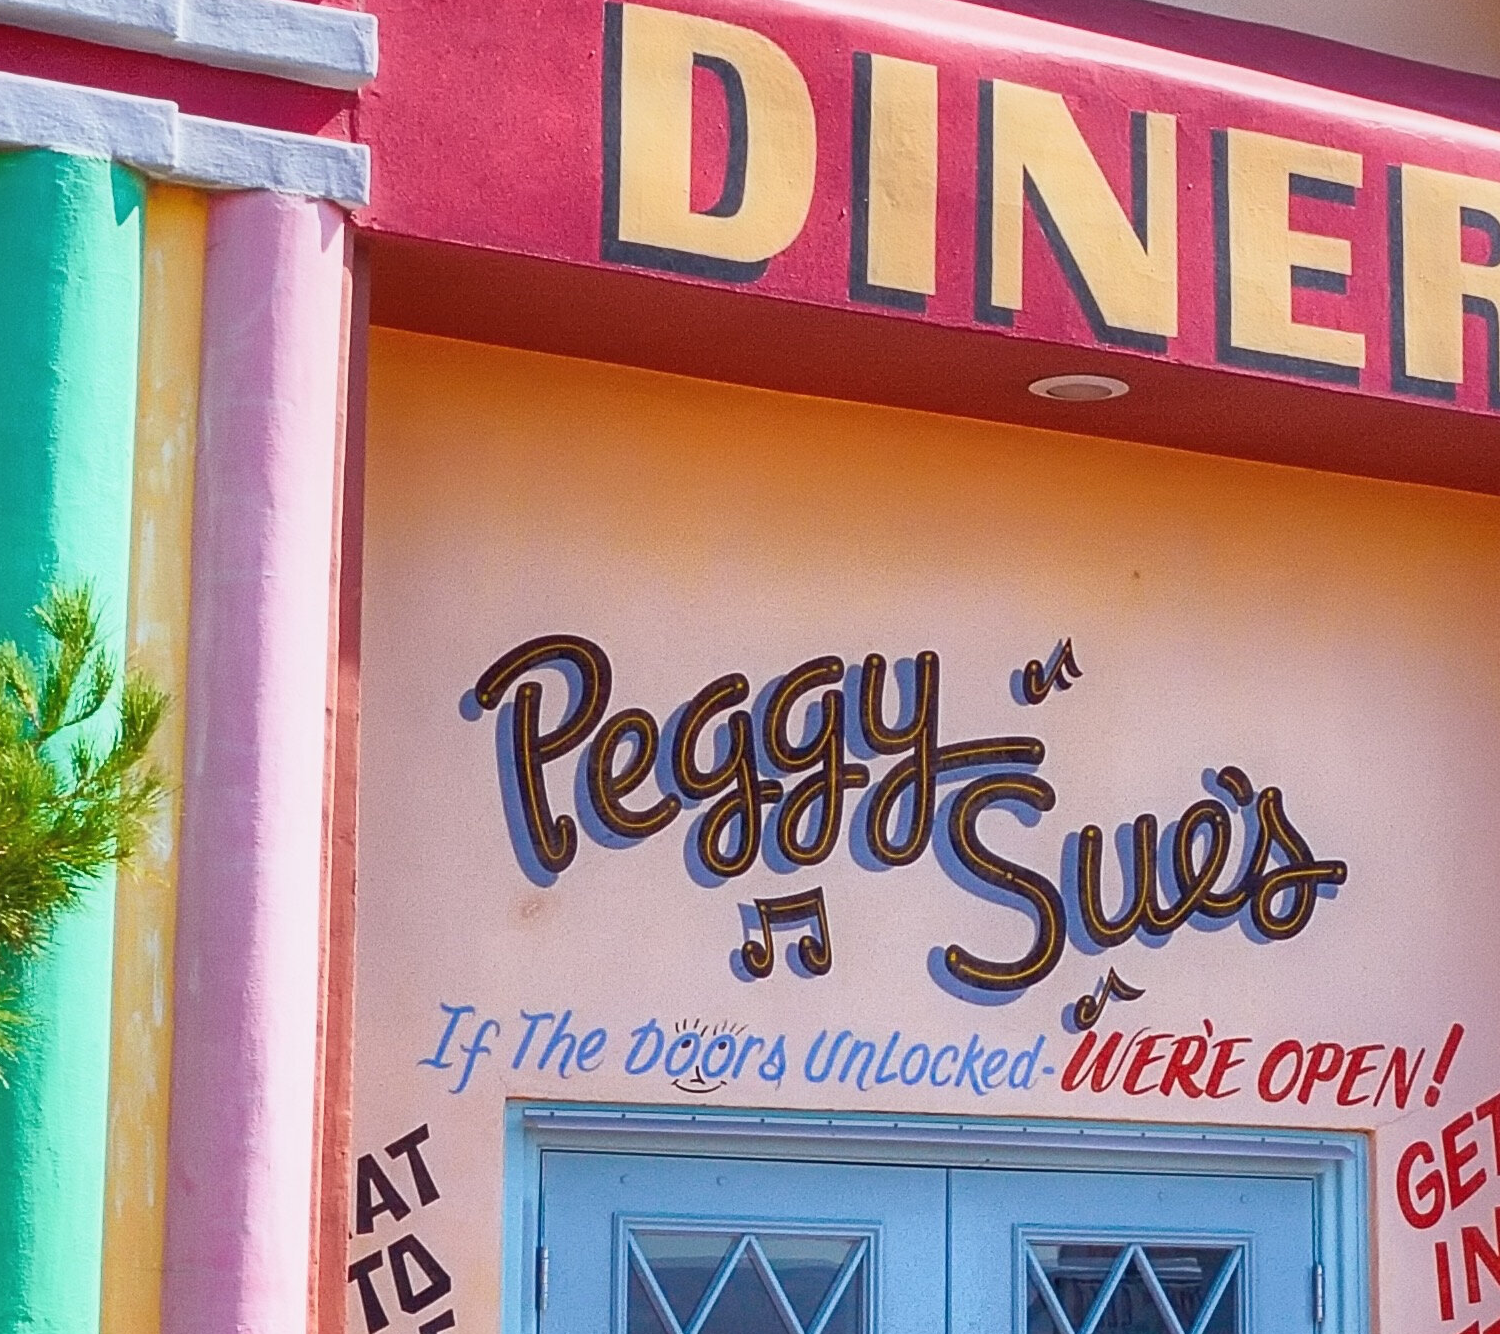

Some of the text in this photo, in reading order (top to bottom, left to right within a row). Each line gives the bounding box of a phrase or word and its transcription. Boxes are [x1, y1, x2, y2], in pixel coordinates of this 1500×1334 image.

[461, 634, 1045, 886] Peggy
[928, 766, 1348, 1005] Sue's
[417, 1002, 500, 1094] If
[511, 1009, 607, 1079] The
[1257, 1023, 1465, 1109] OPEN!
